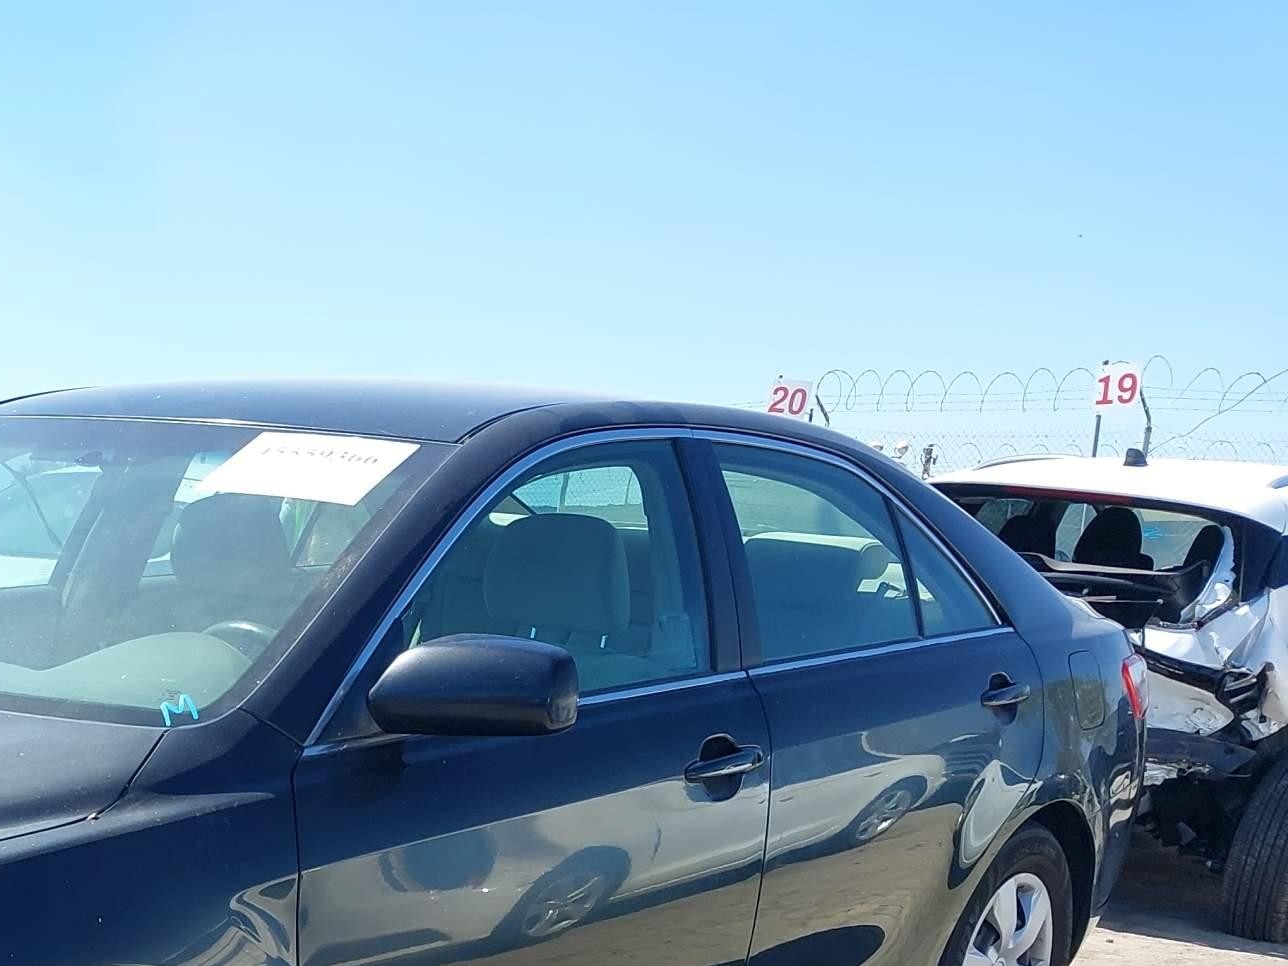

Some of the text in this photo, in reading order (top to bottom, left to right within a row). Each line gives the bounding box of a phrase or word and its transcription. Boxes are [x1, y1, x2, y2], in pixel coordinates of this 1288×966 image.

[767, 386, 807, 415] 20
[1095, 372, 1138, 405] 19
[159, 694, 199, 727] M
